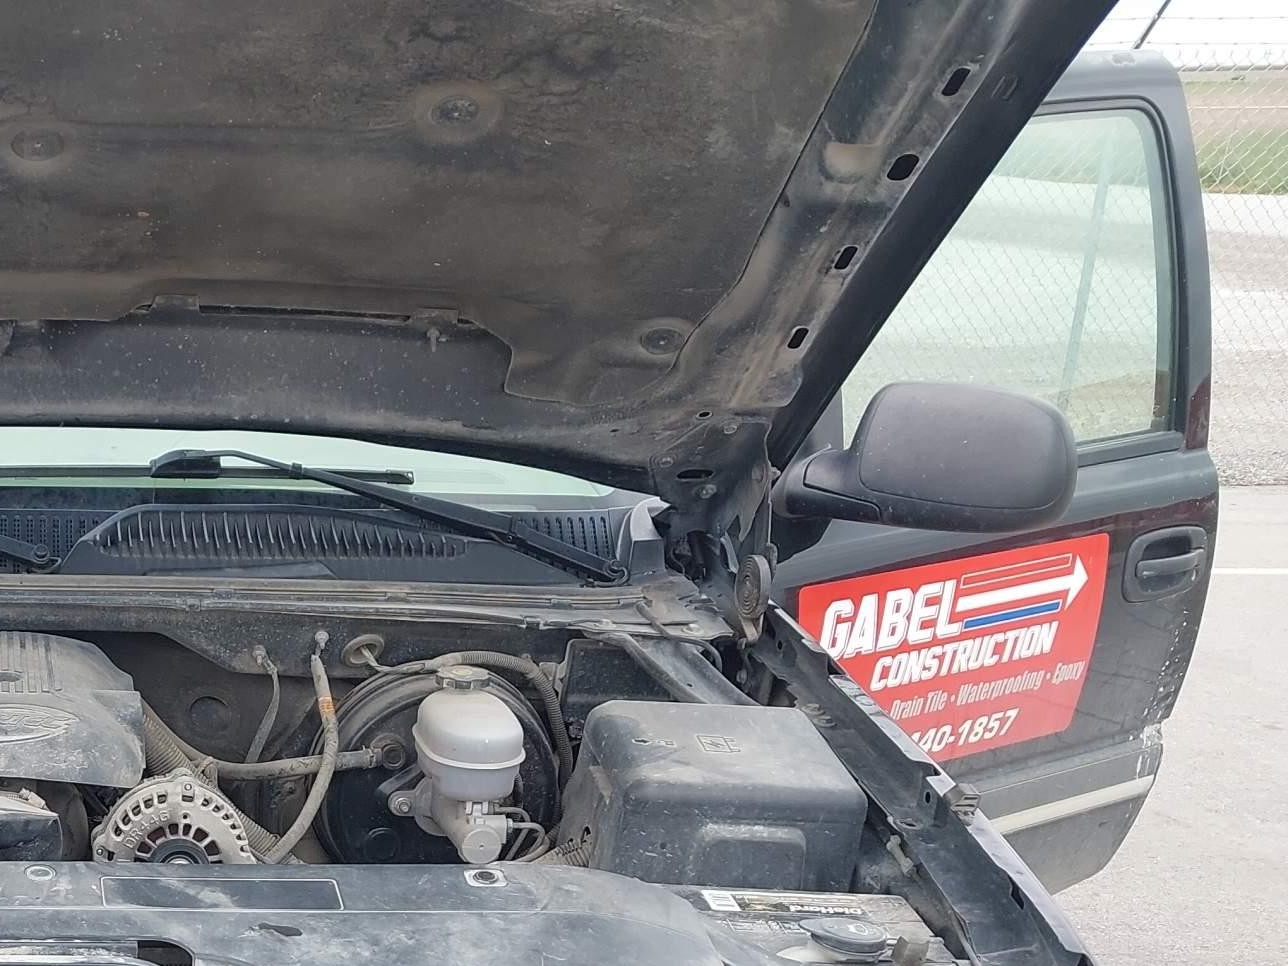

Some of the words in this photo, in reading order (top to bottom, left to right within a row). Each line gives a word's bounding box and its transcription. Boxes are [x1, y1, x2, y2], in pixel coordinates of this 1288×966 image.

[820, 579, 963, 658] GABEL
[870, 622, 1059, 691] CONSTRUCTION
[890, 695, 924, 720] Drain
[924, 692, 947, 713] Tile
[956, 669, 1043, 706] Waterproofing
[1052, 661, 1086, 685] Epoxy
[789, 904, 862, 915] DieHard
